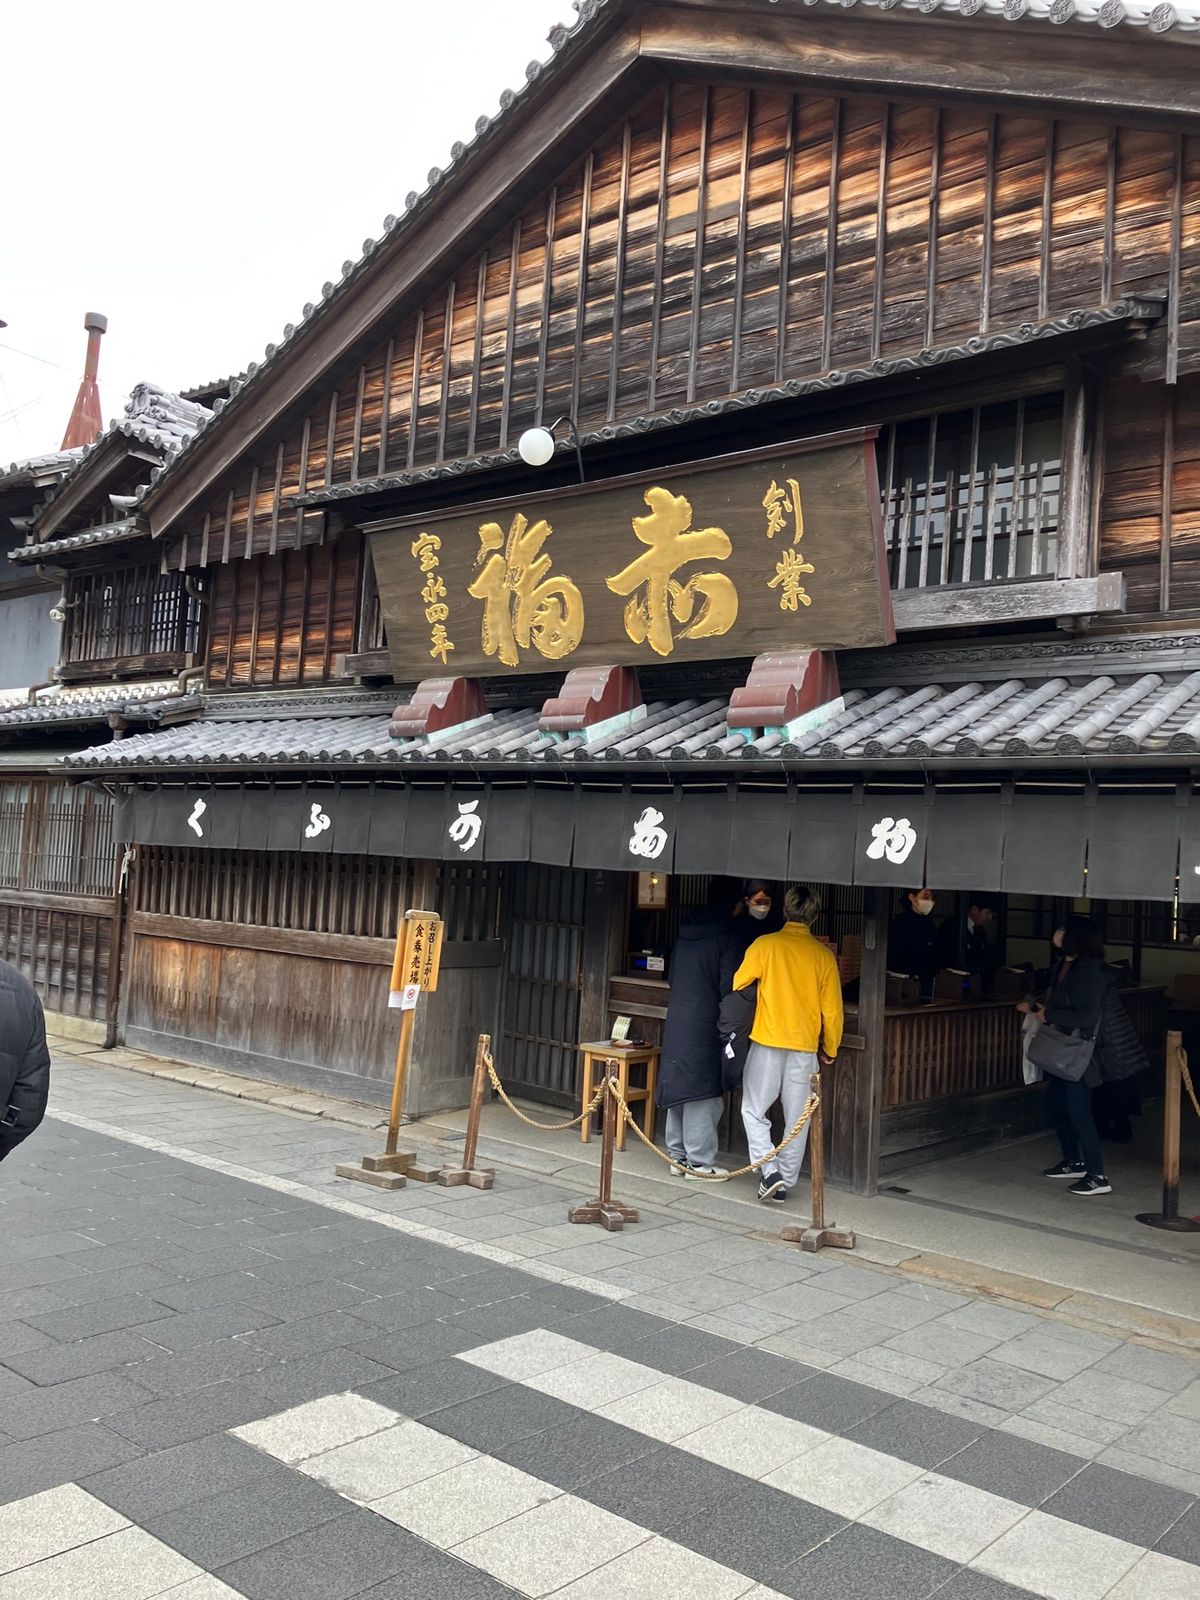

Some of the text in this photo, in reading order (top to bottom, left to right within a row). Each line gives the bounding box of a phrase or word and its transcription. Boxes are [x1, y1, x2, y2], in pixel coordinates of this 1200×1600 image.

[410, 532, 456, 666] 宝永四年
[408, 923, 426, 985] 食券売場
[422, 921, 438, 988] お召し上がり
